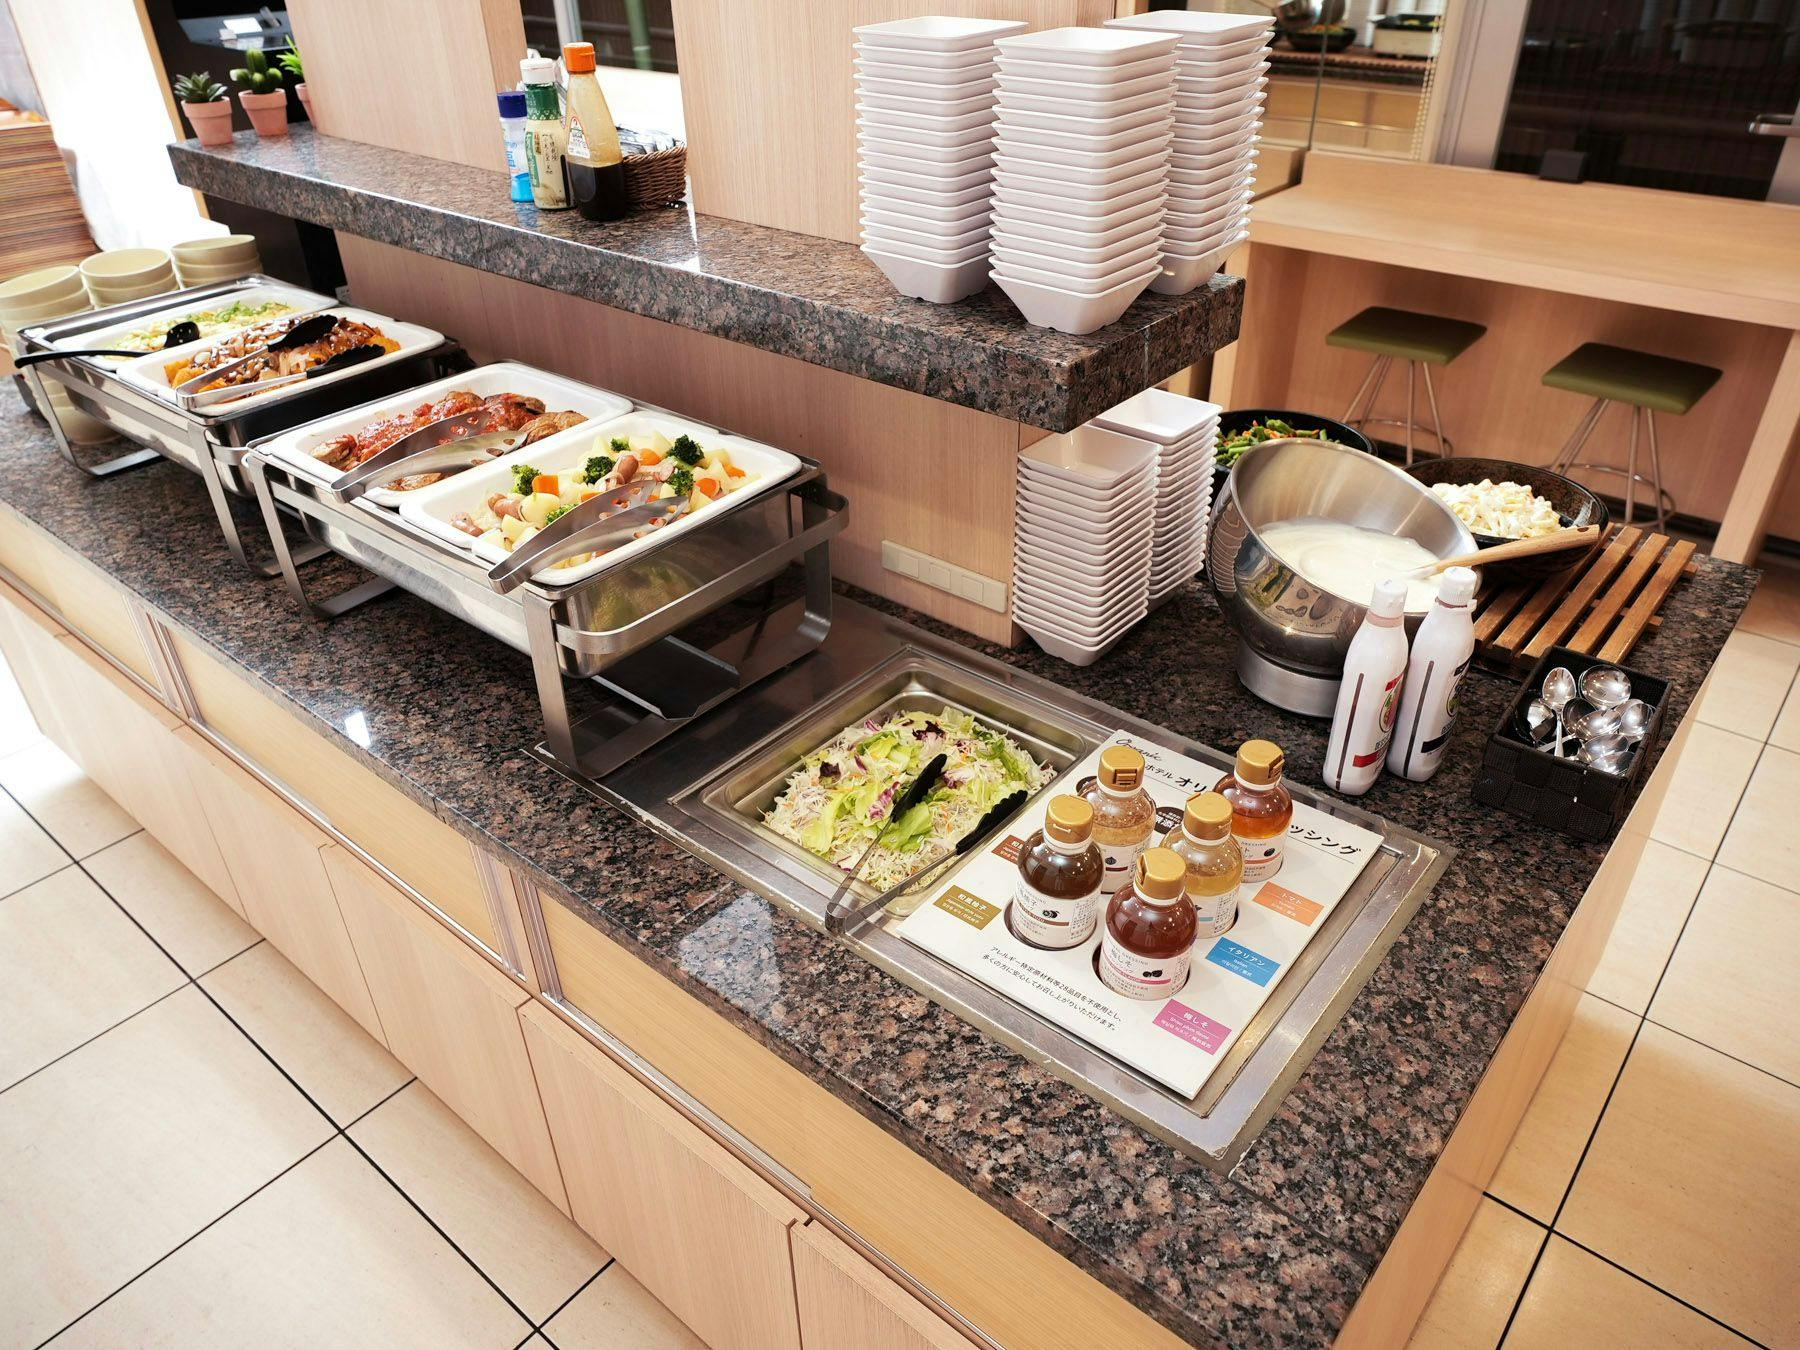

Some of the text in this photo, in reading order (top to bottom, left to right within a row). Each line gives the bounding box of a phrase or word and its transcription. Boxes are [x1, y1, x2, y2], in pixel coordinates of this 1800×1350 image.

[1281, 892, 1303, 905] トマト
[1227, 945, 1266, 967] イタリアン
[1183, 1011, 1209, 1029] 梅しそ
